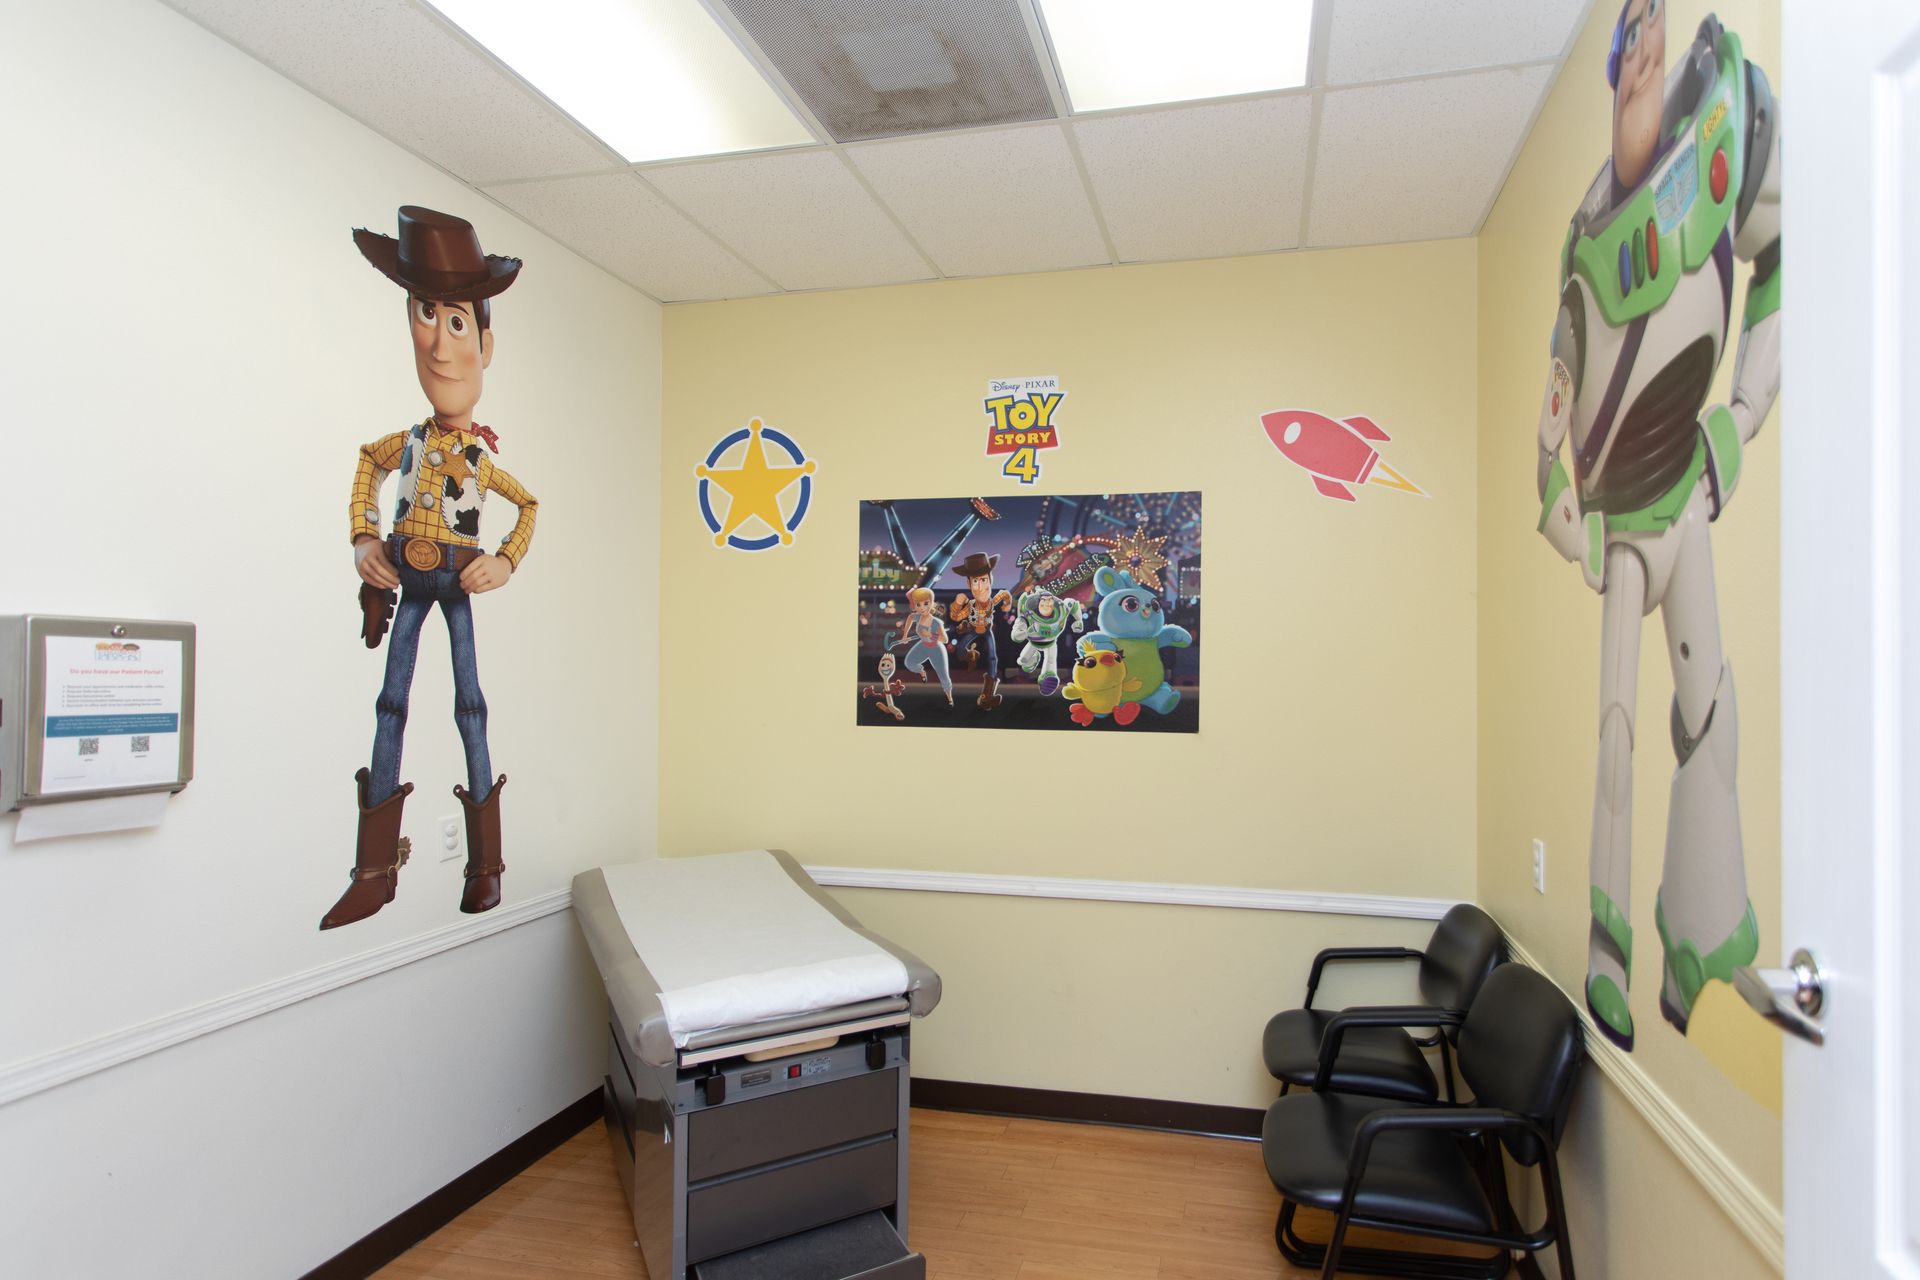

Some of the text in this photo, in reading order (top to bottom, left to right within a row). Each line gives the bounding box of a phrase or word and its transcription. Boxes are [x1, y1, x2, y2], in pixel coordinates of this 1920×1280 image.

[991, 380, 1056, 393] Disney PIXAR
[985, 392, 1064, 433] TOY
[994, 432, 1051, 446] STORY
[1003, 445, 1040, 484] 4
[859, 558, 901, 582] rby
